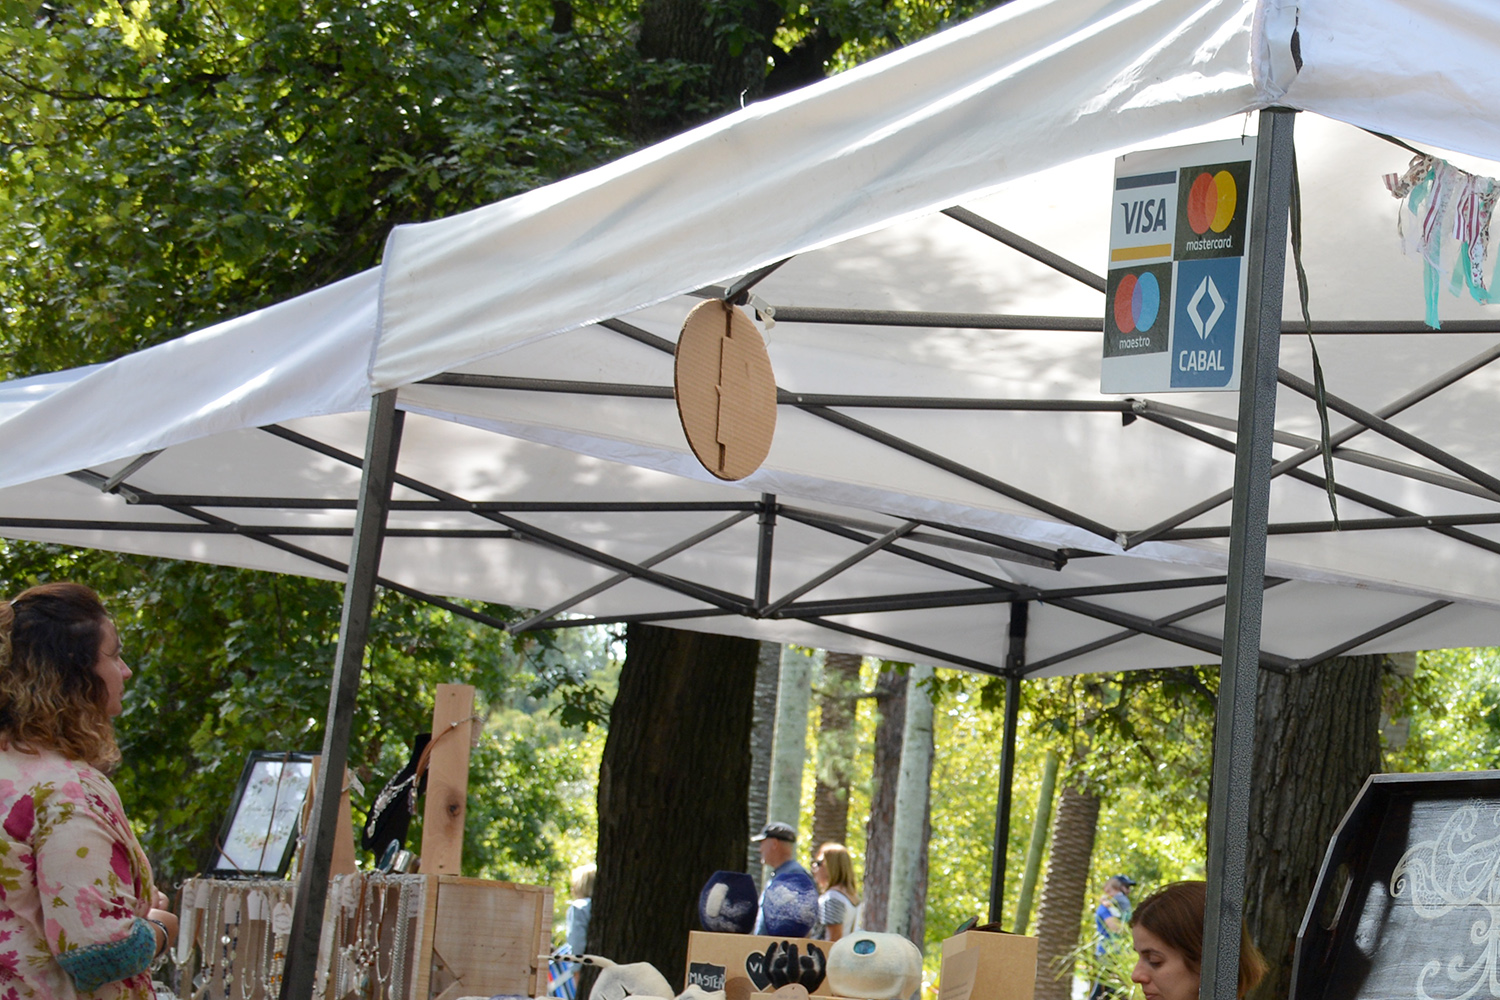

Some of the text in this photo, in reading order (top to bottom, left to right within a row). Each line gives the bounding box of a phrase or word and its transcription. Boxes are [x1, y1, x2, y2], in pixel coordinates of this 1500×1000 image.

[1121, 198, 1167, 235] VISA
[1186, 235, 1233, 252] mastercard
[1118, 336, 1151, 350] maestro
[1178, 349, 1225, 372] CABAL
